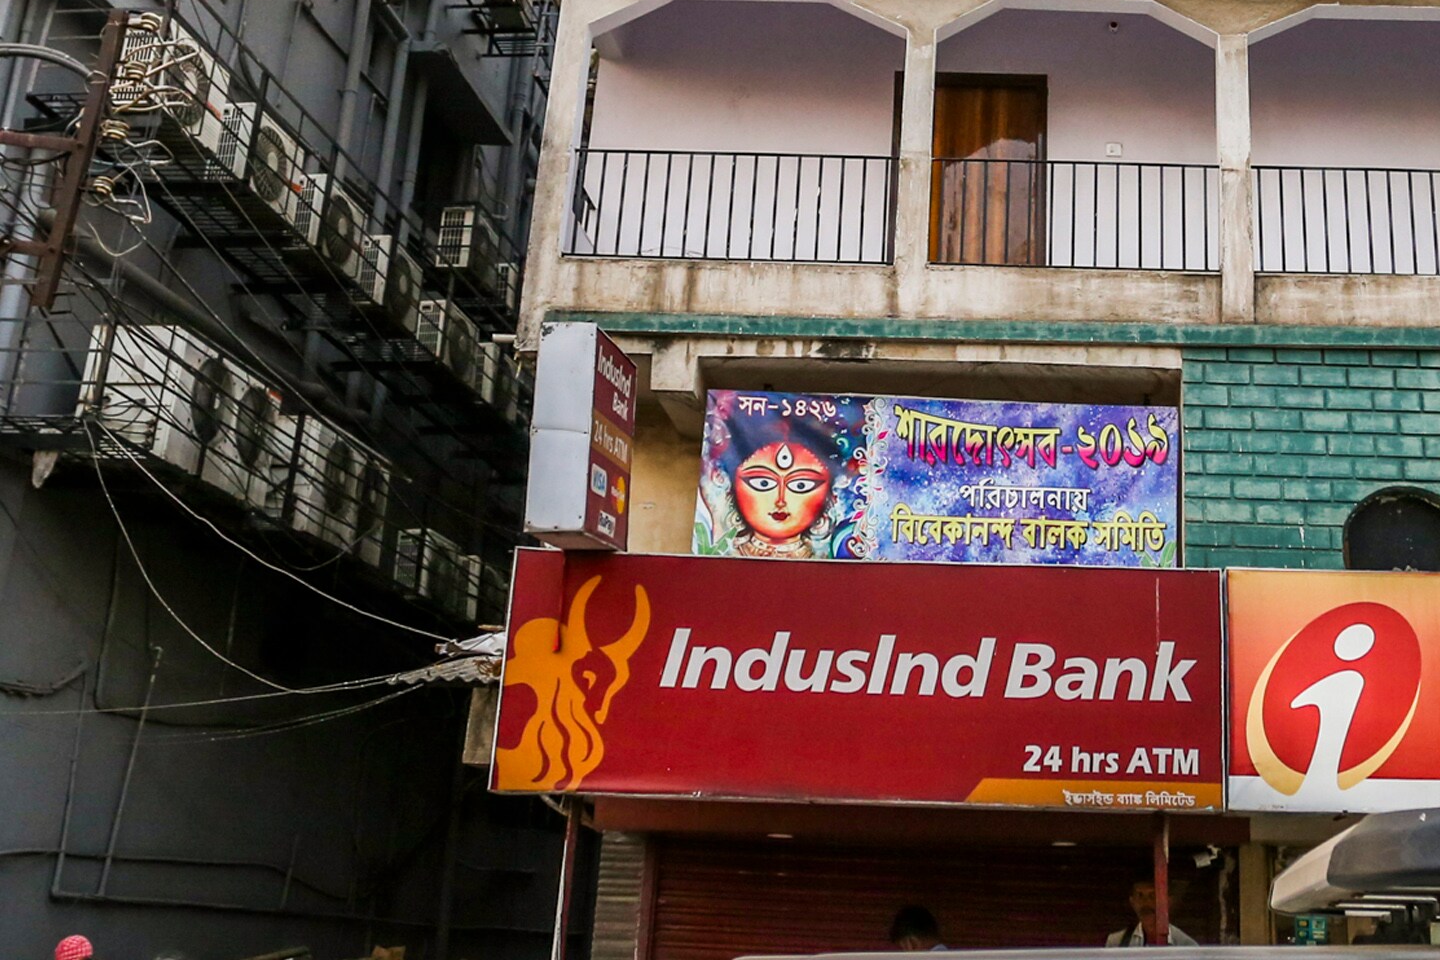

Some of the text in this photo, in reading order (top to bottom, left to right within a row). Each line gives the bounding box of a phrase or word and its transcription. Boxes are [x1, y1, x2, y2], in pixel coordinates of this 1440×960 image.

[598, 345, 632, 399] IndusInd
[612, 392, 629, 422] Bank
[594, 421, 604, 445] 24
[613, 436, 629, 464] ATM
[890, 503, 1167, 551] বিবেকানন্দ বালক সমিতি
[659, 627, 1197, 702] IndusInd Bank
[1023, 744, 1200, 775] 24 hrs ATM
